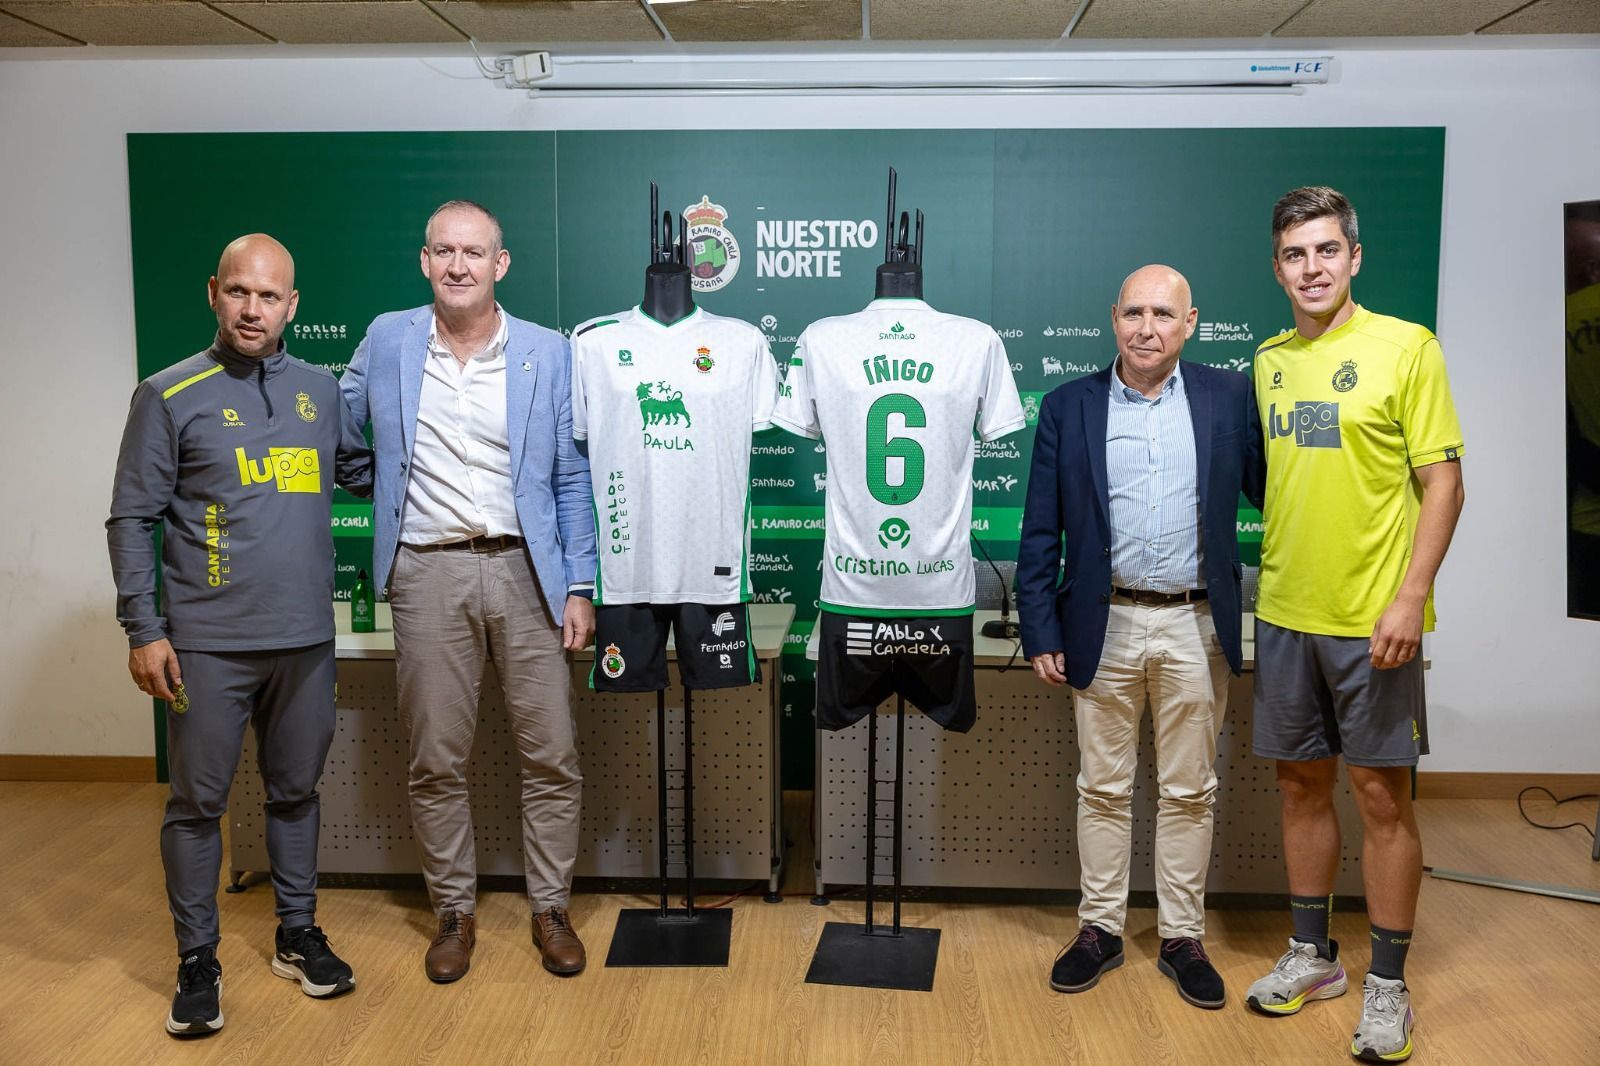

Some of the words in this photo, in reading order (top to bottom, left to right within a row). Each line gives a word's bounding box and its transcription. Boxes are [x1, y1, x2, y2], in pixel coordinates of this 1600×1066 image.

[691, 226, 722, 237] RAMIRO
[723, 237, 737, 259] CARLA
[757, 219, 878, 248] NUESTRO
[757, 250, 841, 278] NORTE
[863, 354, 934, 385] ÍÑIGO
[1065, 362, 1100, 373] PAULA
[1269, 401, 1340, 447] lupa
[643, 433, 694, 451] PAULA
[866, 393, 927, 505] 6
[235, 447, 320, 492] lupa
[341, 517, 370, 528] CARLA
[616, 470, 631, 553] TELECOM
[762, 518, 802, 530] RAMIRO
[803, 518, 826, 529] CARL
[1236, 522, 1264, 532] RAMI
[205, 504, 221, 588] CANTABRIA
[218, 503, 231, 587] TELECOM
[835, 555, 911, 576] Cristina
